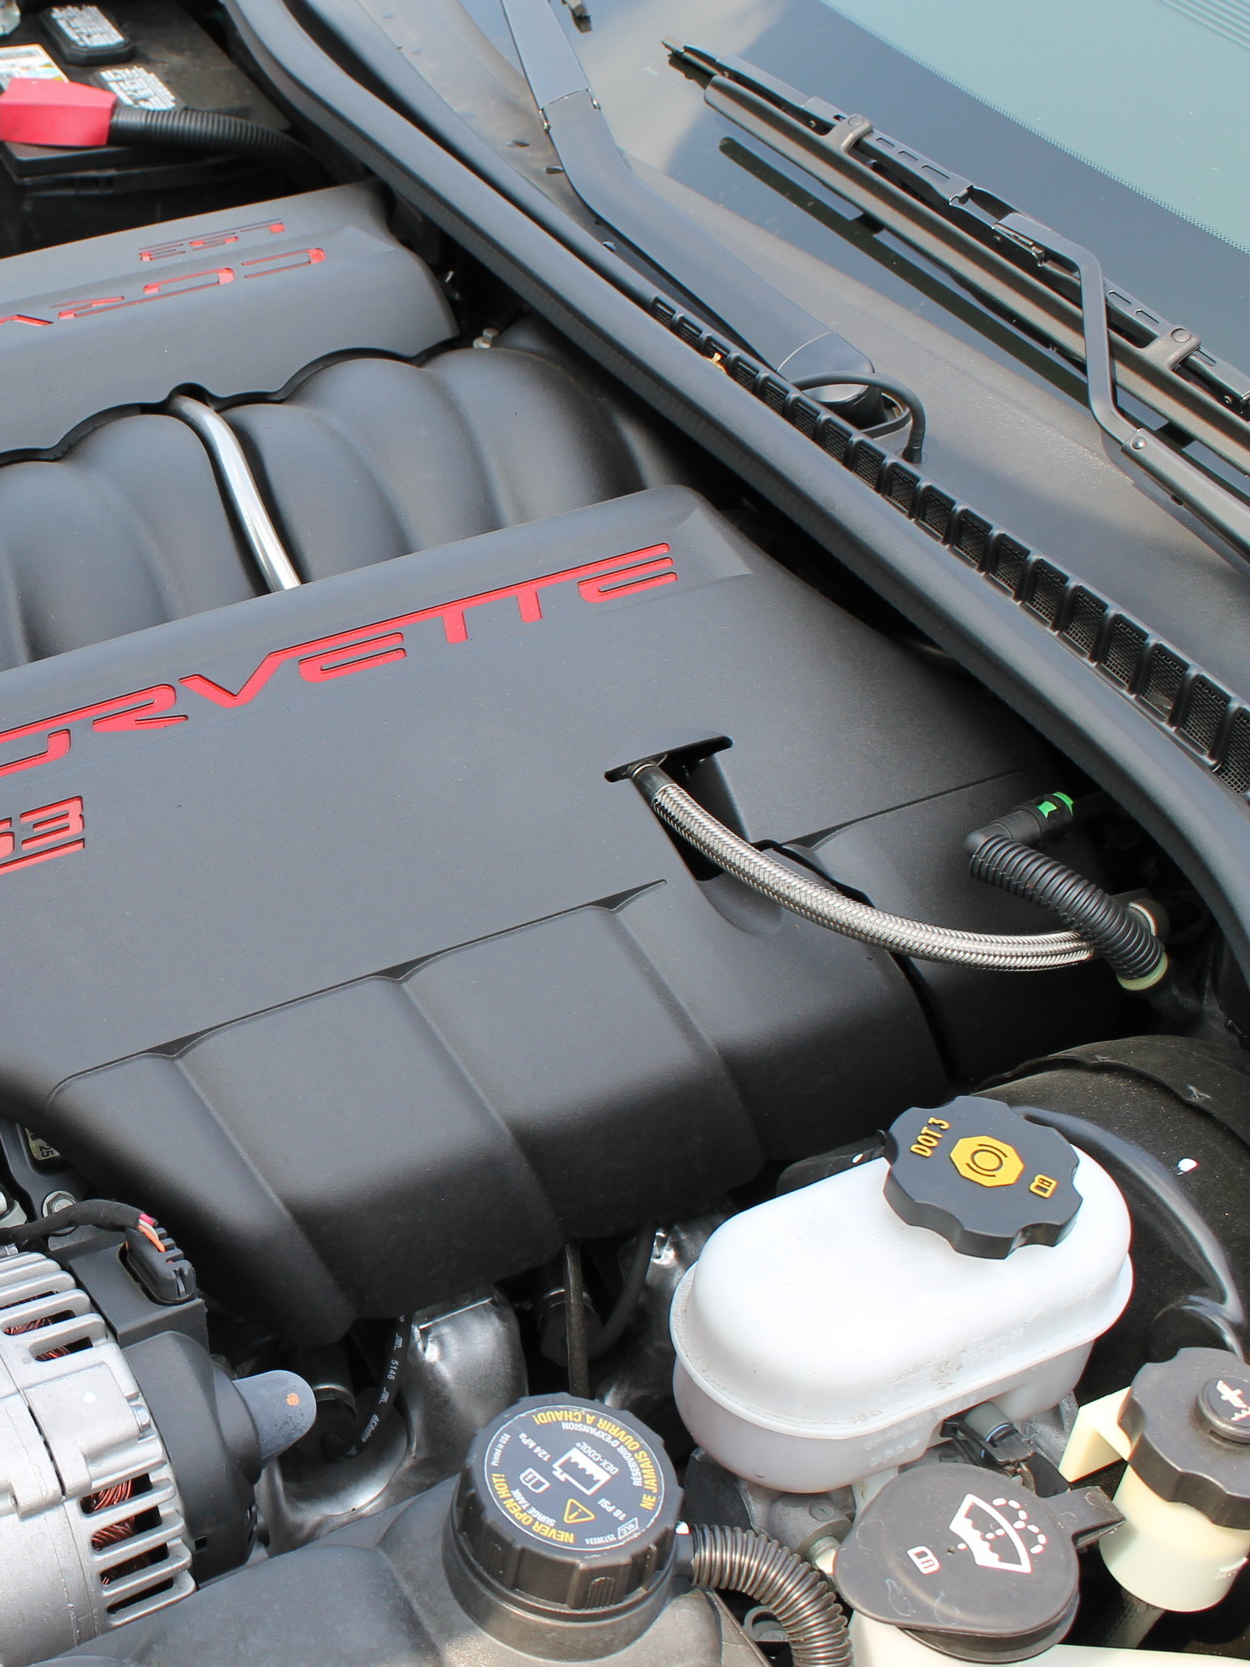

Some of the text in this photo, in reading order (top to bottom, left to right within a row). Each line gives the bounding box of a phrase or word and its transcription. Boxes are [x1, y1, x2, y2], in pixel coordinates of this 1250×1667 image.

[910, 1117, 950, 1157] DOT 3
[387, 1359, 399, 1380] 5146
[532, 1411, 582, 1425] CHAUD!
[518, 1432, 551, 1461] 124 kPa
[562, 1422, 619, 1447] D'EXPANSION
[597, 1417, 641, 1451] OUVRIR
[635, 1451, 658, 1493] JAMAIS
[492, 1473, 574, 1544] NEVER OPEN HOT!
[511, 1488, 556, 1527] SURGE TANK
[597, 1498, 627, 1521] 18 PSI
[640, 1494, 656, 1510] NE
